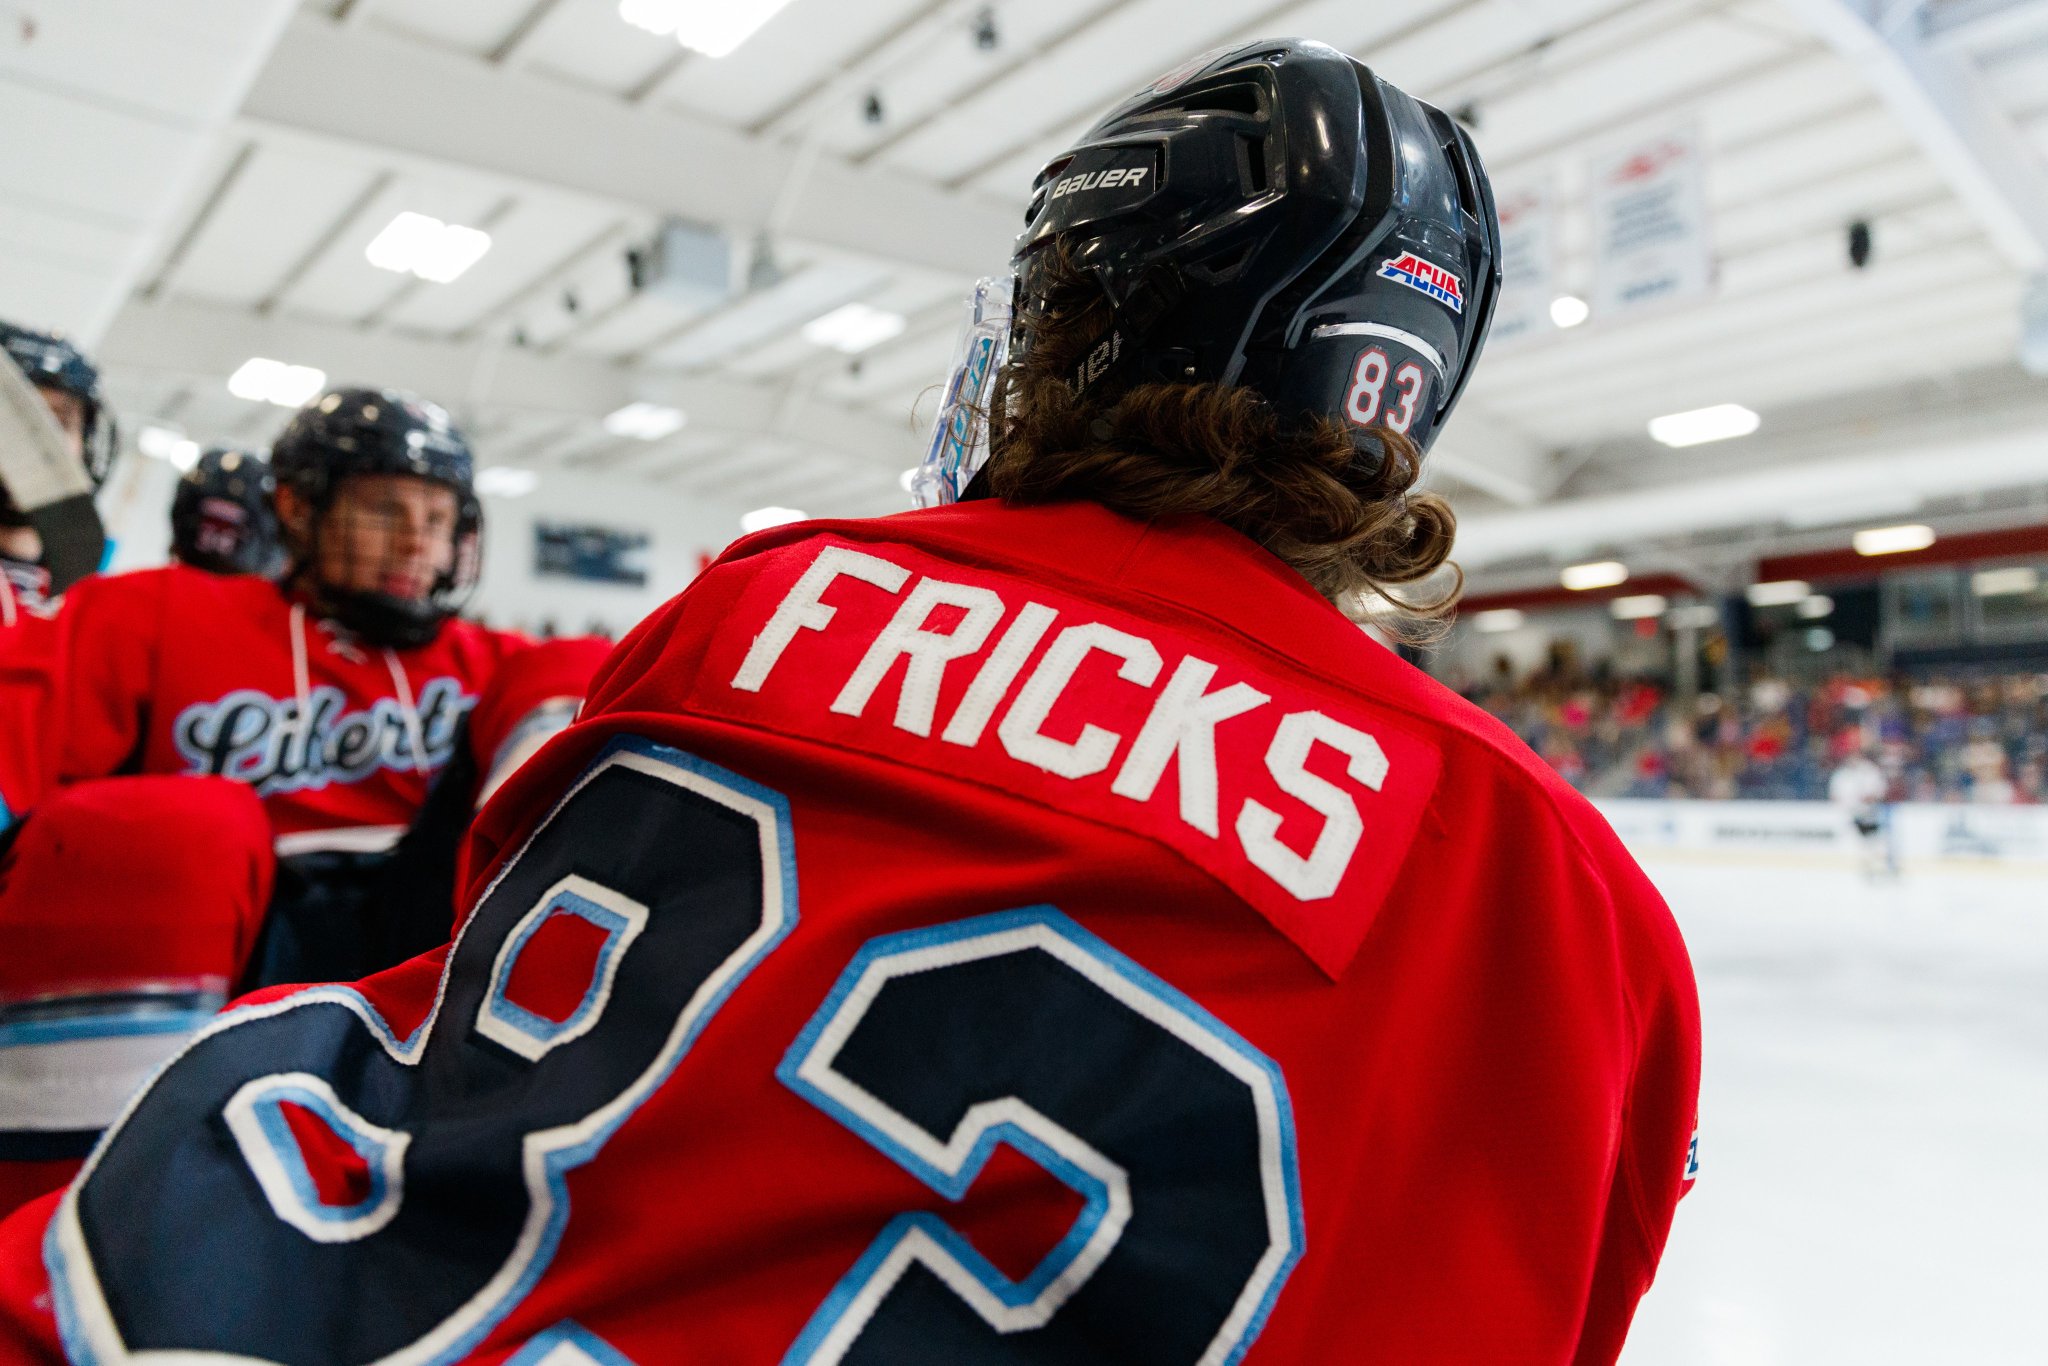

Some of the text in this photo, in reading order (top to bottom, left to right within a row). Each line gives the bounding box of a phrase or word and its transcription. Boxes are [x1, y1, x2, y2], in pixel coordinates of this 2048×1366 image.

[1050, 166, 1149, 200] BAUER
[1381, 254, 1462, 312] ACHA
[1346, 348, 1423, 434] 83
[175, 678, 476, 796] Libert
[730, 545, 1390, 902] FRICKS
[43, 734, 1306, 1366] 83
